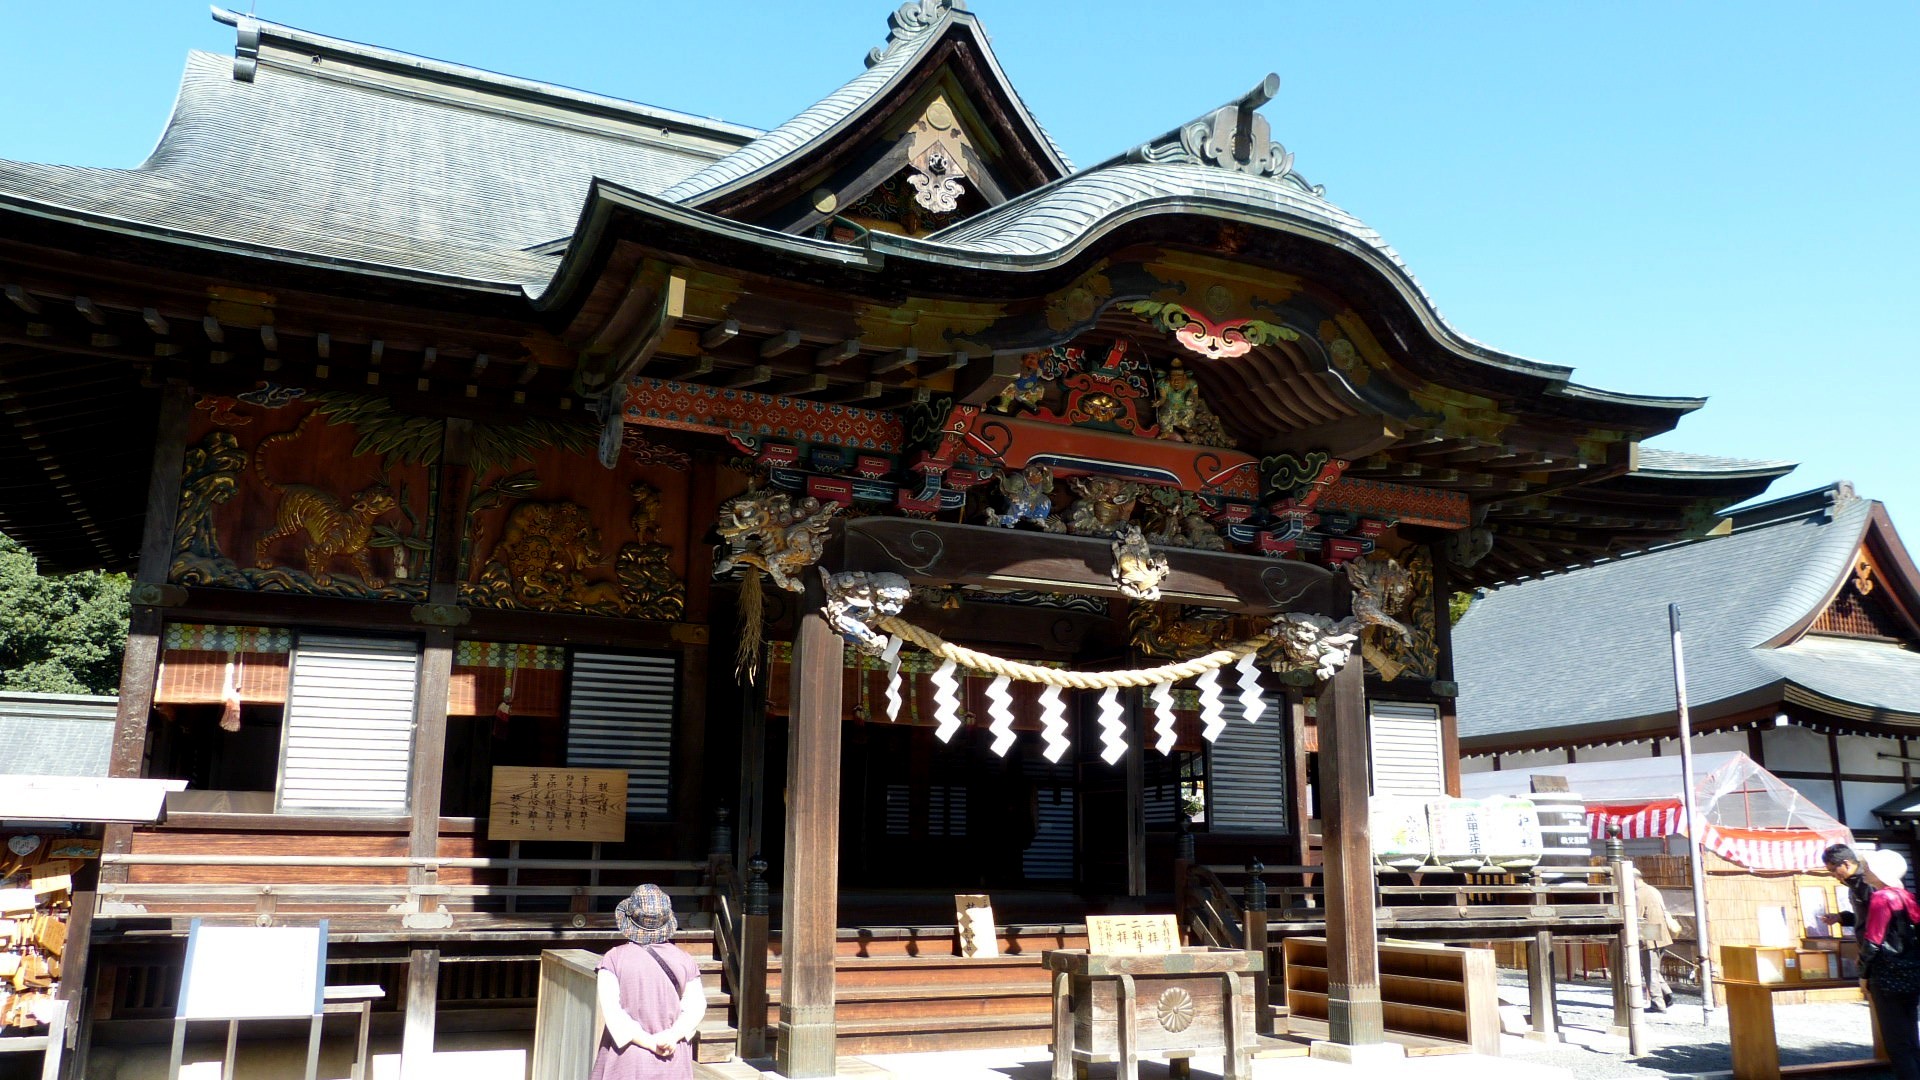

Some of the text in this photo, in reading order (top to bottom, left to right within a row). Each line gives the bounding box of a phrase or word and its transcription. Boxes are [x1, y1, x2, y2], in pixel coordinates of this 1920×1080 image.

[510, 794, 521, 825] 秩父神社
[1465, 811, 1482, 854] 武甲正宗
[1115, 923, 1128, 944] 一拝
[1131, 920, 1144, 952] 二拍手
[1146, 920, 1159, 944] 二拝
